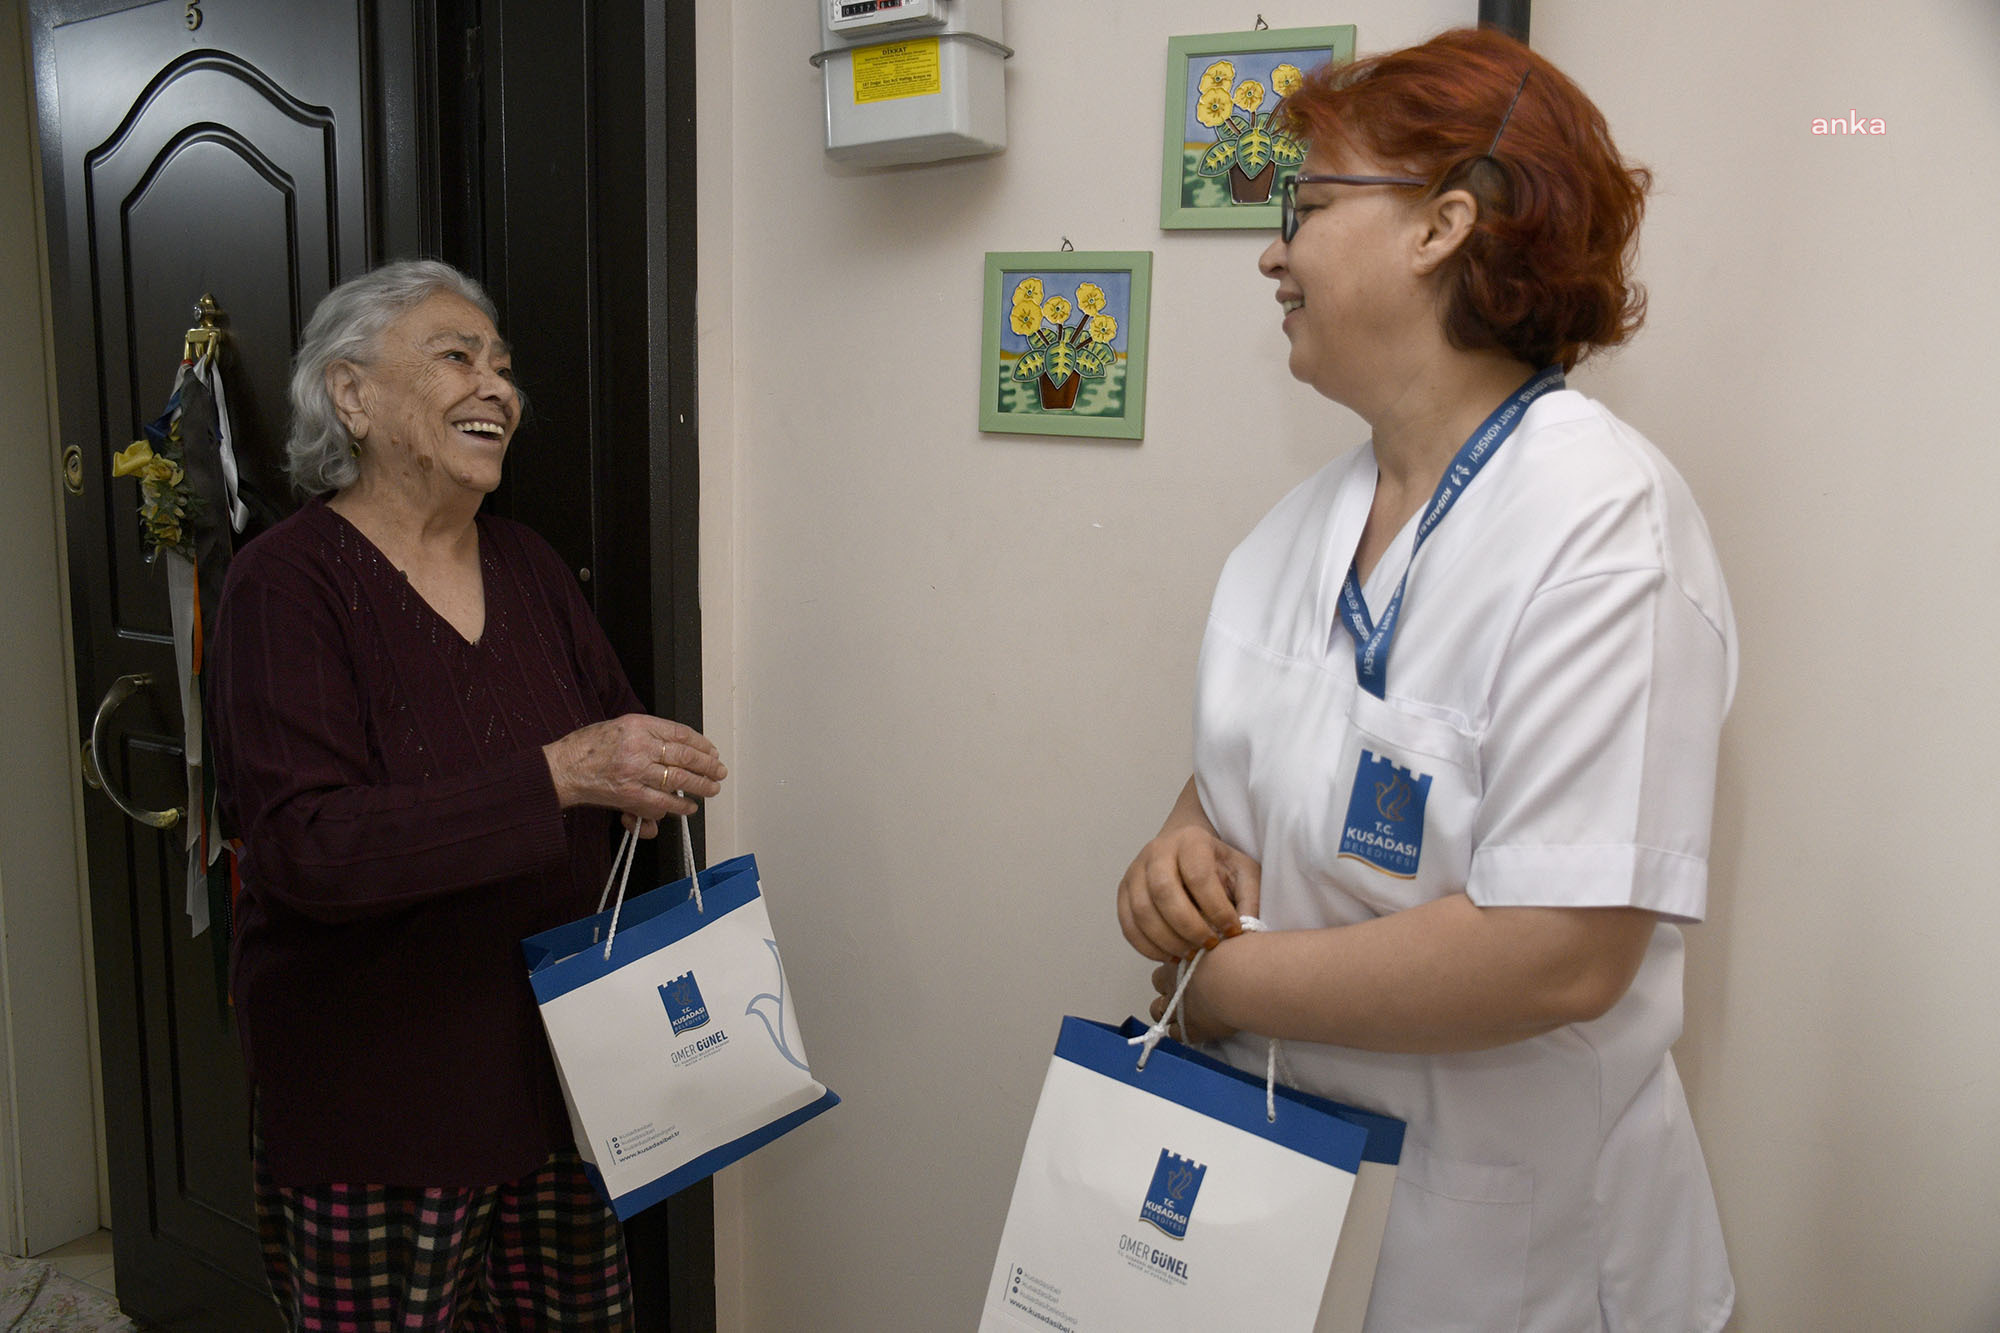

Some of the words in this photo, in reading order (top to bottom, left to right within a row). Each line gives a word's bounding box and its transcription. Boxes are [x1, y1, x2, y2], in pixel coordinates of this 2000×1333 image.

[185, 0, 202, 31] 5
[1498, 404, 1521, 425] KENT
[1375, 822, 1394, 835] T.C.
[1163, 1198, 1174, 1208] T.C.
